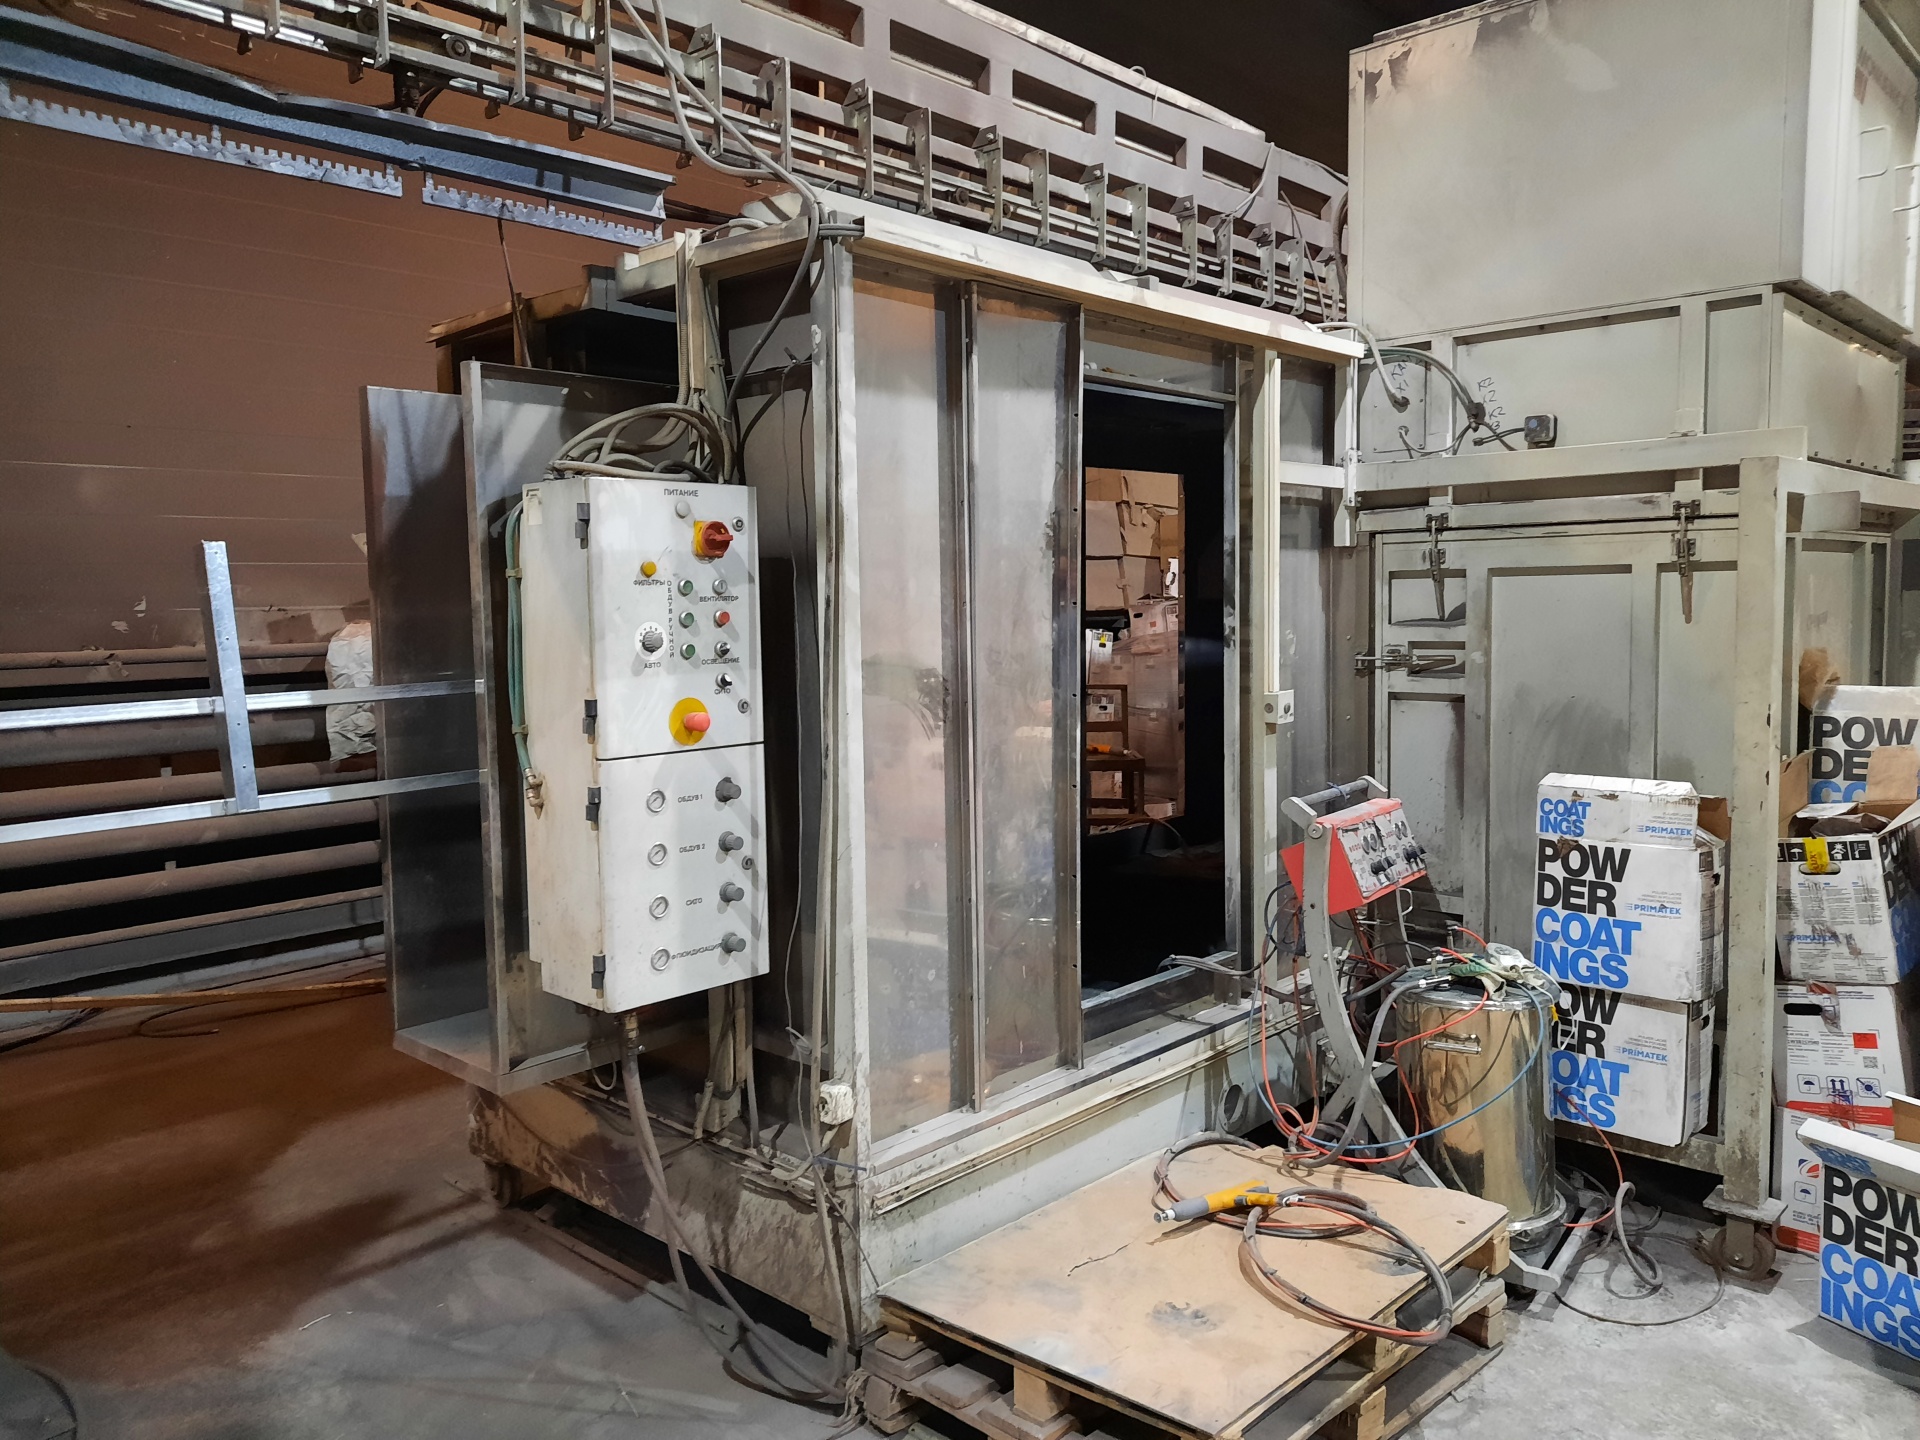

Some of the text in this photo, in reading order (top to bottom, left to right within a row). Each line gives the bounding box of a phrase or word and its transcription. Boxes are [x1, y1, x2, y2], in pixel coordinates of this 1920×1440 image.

[663, 488, 699, 498] ПИТАНИЕ
[633, 579, 666, 587] ФИЛЬТРЫ
[699, 595, 739, 603] ВЕНТИЛЯТОР
[643, 661, 662, 670] АВТО
[701, 656, 740, 666] ОСВЕЩЕНИЕ
[1813, 715, 1919, 750] POW
[1811, 747, 1872, 782] DE
[677, 794, 700, 804] ОБДУВ
[1540, 798, 1592, 821] COAT
[1539, 815, 1585, 837] INGS
[1644, 825, 1693, 837] PRIMATEK
[679, 844, 701, 854] ОБДУВ
[1537, 838, 1632, 883] POW
[1536, 871, 1617, 918] DER
[1633, 903, 1682, 915] PRIMATEK
[1535, 907, 1642, 956] COAT
[1534, 940, 1629, 989] INGS
[1555, 982, 1623, 1026] OW
[1551, 1016, 1606, 1060] ER
[1622, 1047, 1668, 1062] PRIMATEK
[1551, 1050, 1630, 1097] OAT
[1824, 1163, 1920, 1240] POW
[1823, 1202, 1919, 1278] DER
[1822, 1243, 1920, 1318] COA
